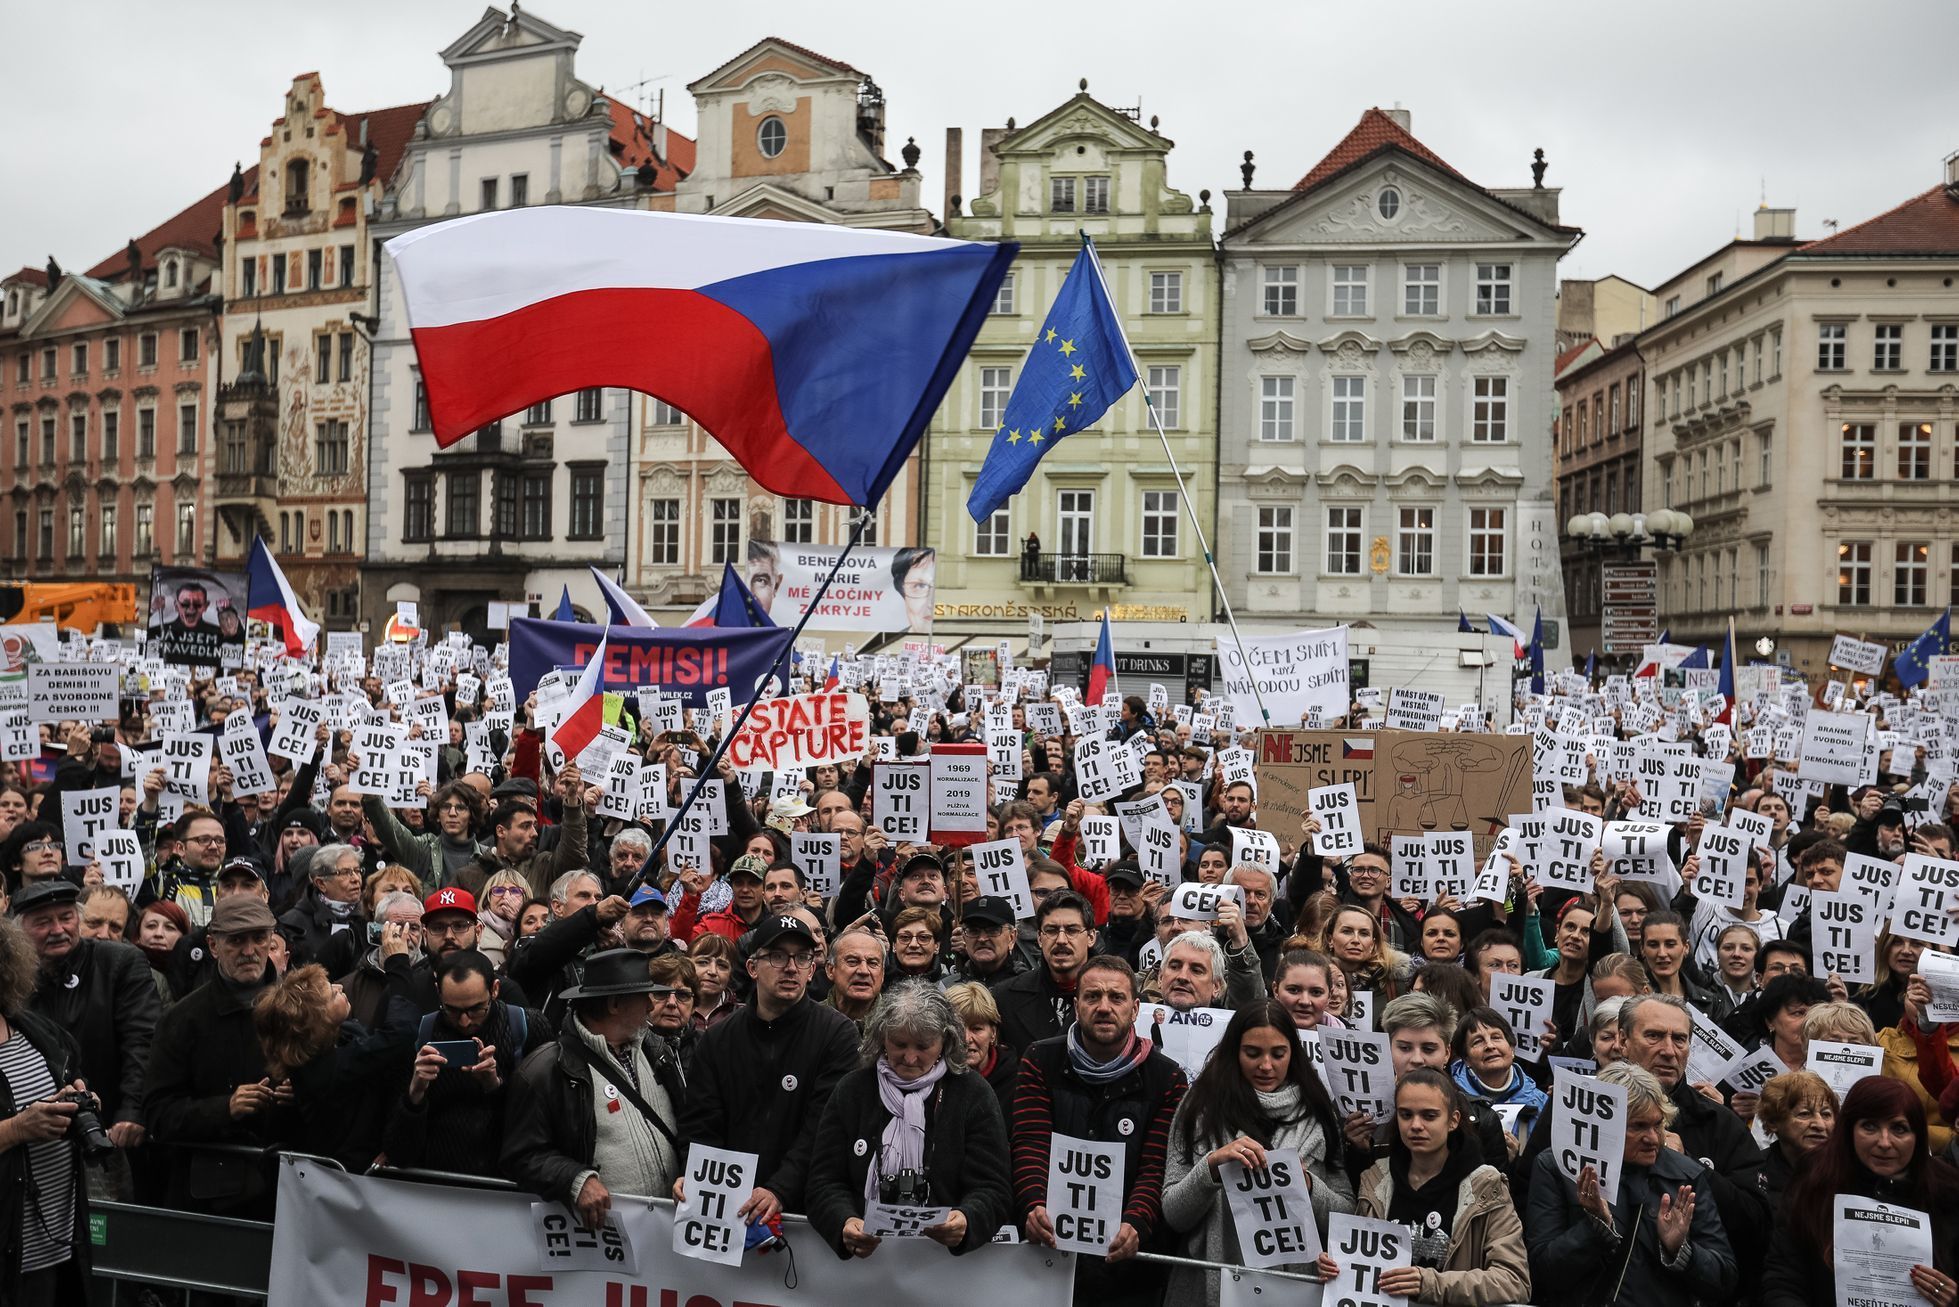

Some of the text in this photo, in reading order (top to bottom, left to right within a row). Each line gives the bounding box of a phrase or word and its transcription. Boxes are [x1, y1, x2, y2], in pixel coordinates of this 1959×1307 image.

[788, 586, 883, 601] MÉ LOČINY
[934, 601, 1077, 618] STAROMĚSTSKÁ
[179, 631, 218, 644] JSEM
[1229, 650, 1240, 666] O
[1249, 646, 1290, 666] ČEM
[55, 668, 111, 676] BABIŠOVU
[1115, 659, 1170, 671] OT DRINKS
[1272, 664, 1296, 675] KDYŽ
[1227, 667, 1345, 694] NÁHODOU SEDÍM
[53, 692, 113, 701] SVOBODNÉ
[1396, 689, 1439, 702] KRÁST UŽ MU
[48, 705, 86, 713] ČESKO
[289, 705, 320, 723] JUS
[750, 694, 848, 735] STATE
[1389, 708, 1439, 722] SPRAVEDLNOST
[6, 715, 32, 727] JUS
[292, 721, 307, 737] TI
[12, 729, 26, 741] TI
[361, 733, 395, 749] JUS
[992, 736, 1016, 746] JUS
[1813, 736, 1853, 747] SVOBODU
[8, 743, 32, 755] CE!
[165, 741, 203, 757] JUS
[227, 738, 254, 755] JUS
[278, 737, 307, 755] CE!
[730, 720, 864, 769] CAPTURE
[1076, 740, 1100, 762] JUS
[1264, 734, 1332, 763] NEJSME
[1563, 741, 1585, 752] JUS
[235, 756, 254, 770] TI
[367, 752, 385, 768] TI
[997, 750, 1010, 762] TI
[1567, 753, 1579, 765] TI
[1804, 755, 1857, 767] DEMOKRACII
[171, 761, 192, 779] TI
[611, 760, 634, 776] JUS
[993, 765, 1015, 776] CE!
[1082, 760, 1099, 778] TI
[1560, 766, 1582, 778] CE!
[1639, 759, 1665, 776] JUS
[237, 773, 266, 789] CE!
[358, 771, 389, 788] CE!
[611, 777, 625, 793] TI
[640, 771, 660, 785] JUS
[882, 774, 920, 790] JUS
[168, 783, 198, 799] CE!
[643, 786, 654, 799] TI
[1081, 778, 1111, 799] CE!
[1645, 779, 1658, 797] TI
[73, 797, 112, 816] JUS
[604, 795, 629, 812] CE!
[639, 801, 660, 814] CE!
[890, 795, 910, 812] TI
[1315, 792, 1348, 810] JUS
[1639, 800, 1662, 818] CE!
[83, 819, 105, 838] TI
[884, 817, 917, 833] CE!
[1324, 812, 1344, 829] TI
[1553, 817, 1593, 838] JUS
[1615, 825, 1660, 833] JUS
[101, 839, 135, 856] JUS
[798, 840, 832, 855] JUS
[1321, 832, 1353, 850] CE!
[1431, 840, 1464, 855] JUS
[1560, 839, 1582, 860] TI
[1622, 836, 1646, 854] TI
[1704, 834, 1740, 855] JUS
[980, 849, 1014, 869] JUS
[1398, 844, 1425, 858] JUS
[111, 861, 131, 879] TI
[805, 859, 823, 874] TI
[1405, 861, 1422, 876] TI
[1438, 859, 1457, 875] TI
[1549, 861, 1587, 883] CE!
[1614, 859, 1655, 875] CE!
[1708, 856, 1728, 876] TI
[988, 872, 1010, 892] TI
[1852, 864, 1892, 887] JUS
[1912, 865, 1959, 887] JUS
[803, 878, 830, 893] CE!
[1400, 879, 1427, 894] CE!
[1435, 880, 1466, 896] CE!
[1698, 876, 1733, 899] CE!
[1919, 887, 1944, 910] TI
[1820, 901, 1863, 923] JUS
[1904, 910, 1948, 936] CE!
[1828, 926, 1851, 948] TI
[1822, 952, 1860, 973] CE!
[1500, 984, 1543, 1006] JUS
[1508, 1007, 1531, 1029] TI
[1693, 1025, 1709, 1041] EJSME
[1330, 1039, 1379, 1065] JUS
[1824, 1054, 1846, 1062] NEJSME
[1342, 1068, 1370, 1093] TI
[1739, 1060, 1778, 1089] JUS
[1341, 1098, 1385, 1120] CE!
[1563, 1085, 1614, 1120] JUS
[1571, 1118, 1599, 1151] TI
[1059, 1150, 1111, 1179] JUS
[1562, 1150, 1607, 1187] CE!
[694, 1159, 743, 1188] JUS
[1236, 1162, 1291, 1192] JUS
[699, 1190, 726, 1219] TI
[1067, 1182, 1096, 1211] TI
[1253, 1195, 1287, 1221] TI
[1855, 1211, 1884, 1220] NEJSME
[543, 1214, 571, 1257] CE!
[574, 1226, 598, 1248] TI
[685, 1221, 731, 1252] CE!
[1056, 1214, 1105, 1244] CE!
[1254, 1226, 1305, 1256] CE!
[1340, 1229, 1399, 1260] JUS
